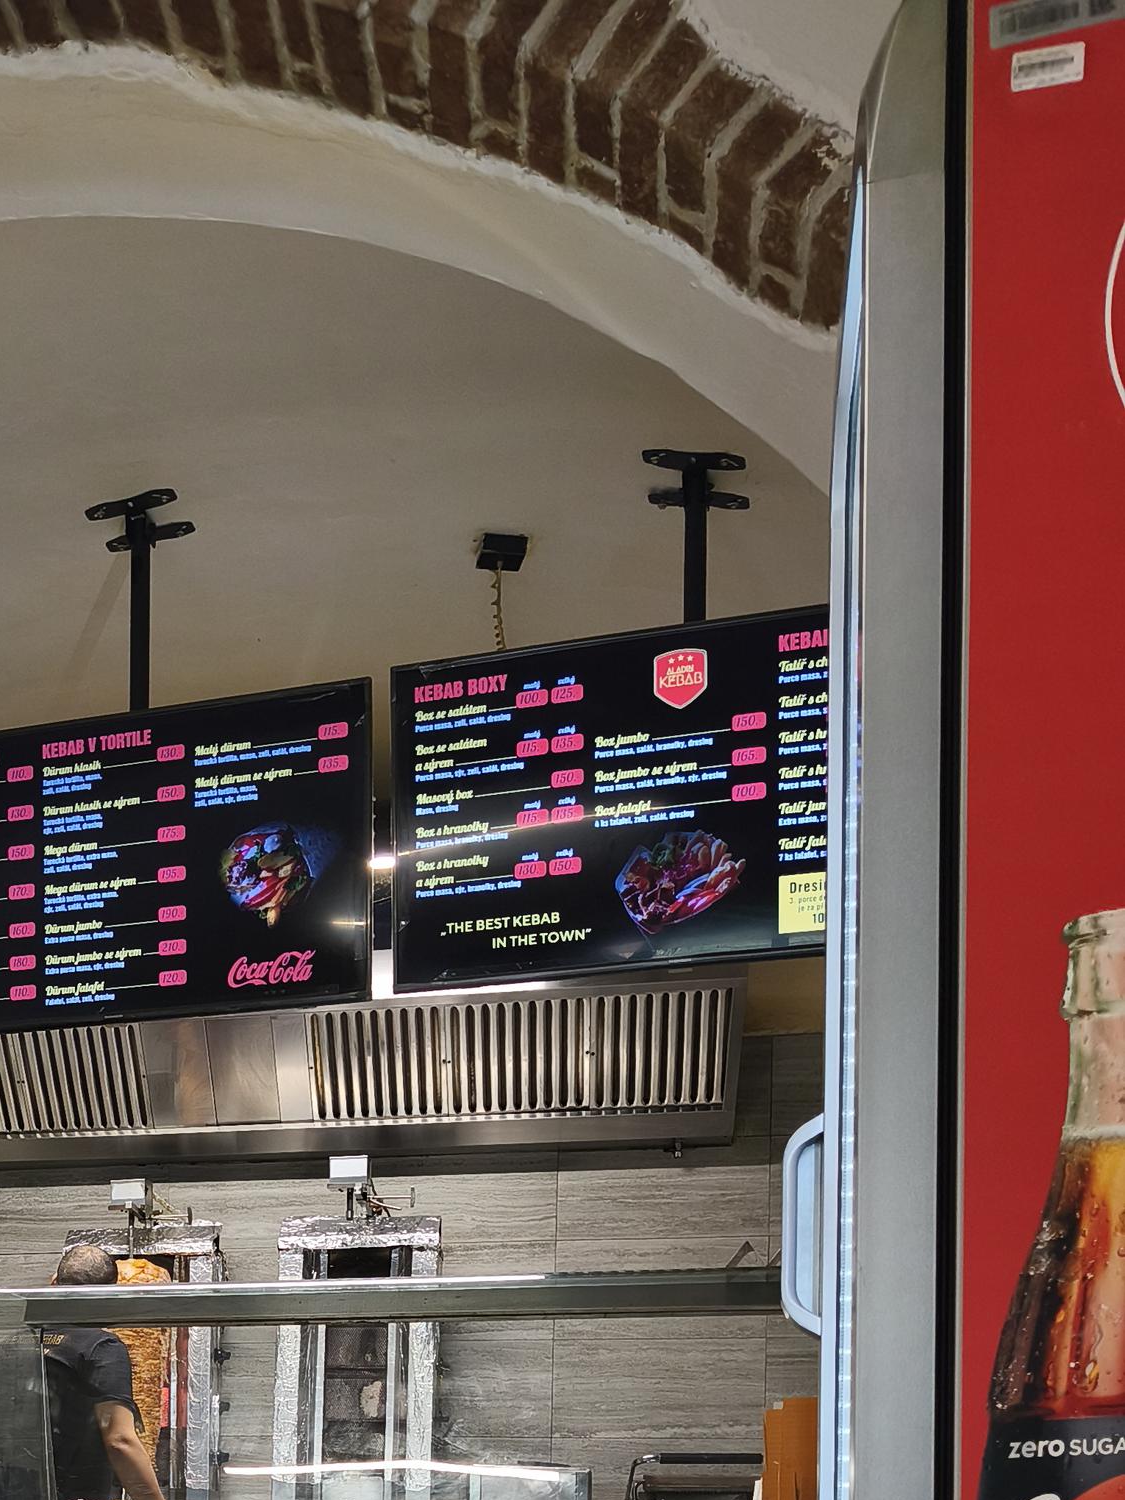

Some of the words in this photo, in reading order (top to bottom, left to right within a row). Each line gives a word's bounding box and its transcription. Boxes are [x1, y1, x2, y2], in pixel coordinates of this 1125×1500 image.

[779, 629, 827, 652] KEBA
[659, 672, 702, 688] KEBAB
[414, 681, 463, 703] KEBAB
[468, 674, 507, 695] BOXY
[415, 711, 434, 722] Box
[43, 740, 84, 759] KEBAB
[88, 738, 96, 752] V
[100, 729, 151, 751] TORTILE
[595, 736, 615, 748] Box
[615, 732, 650, 748] jumbo
[416, 745, 434, 755] Box
[74, 760, 101, 772] klasik
[595, 771, 615, 782] Box
[615, 767, 649, 782] jumbo
[456, 789, 473, 800] box
[75, 801, 101, 812] klasik
[595, 805, 615, 817] Box
[416, 828, 435, 838] Box
[443, 821, 489, 835] hranolky
[44, 845, 67, 856] Mega
[416, 861, 435, 872] Box
[443, 855, 489, 869] hranolky
[45, 885, 67, 896] Mega
[790, 881, 825, 893] Dresi
[74, 920, 102, 934] jumbo
[476, 917, 510, 931] BEST
[513, 912, 560, 927] KEBAB
[492, 937, 506, 948] IN
[510, 934, 537, 947] THE
[75, 952, 103, 965] jumbo
[1008, 1439, 1065, 1459] zero
[1068, 1437, 1125, 1455] SUGA
